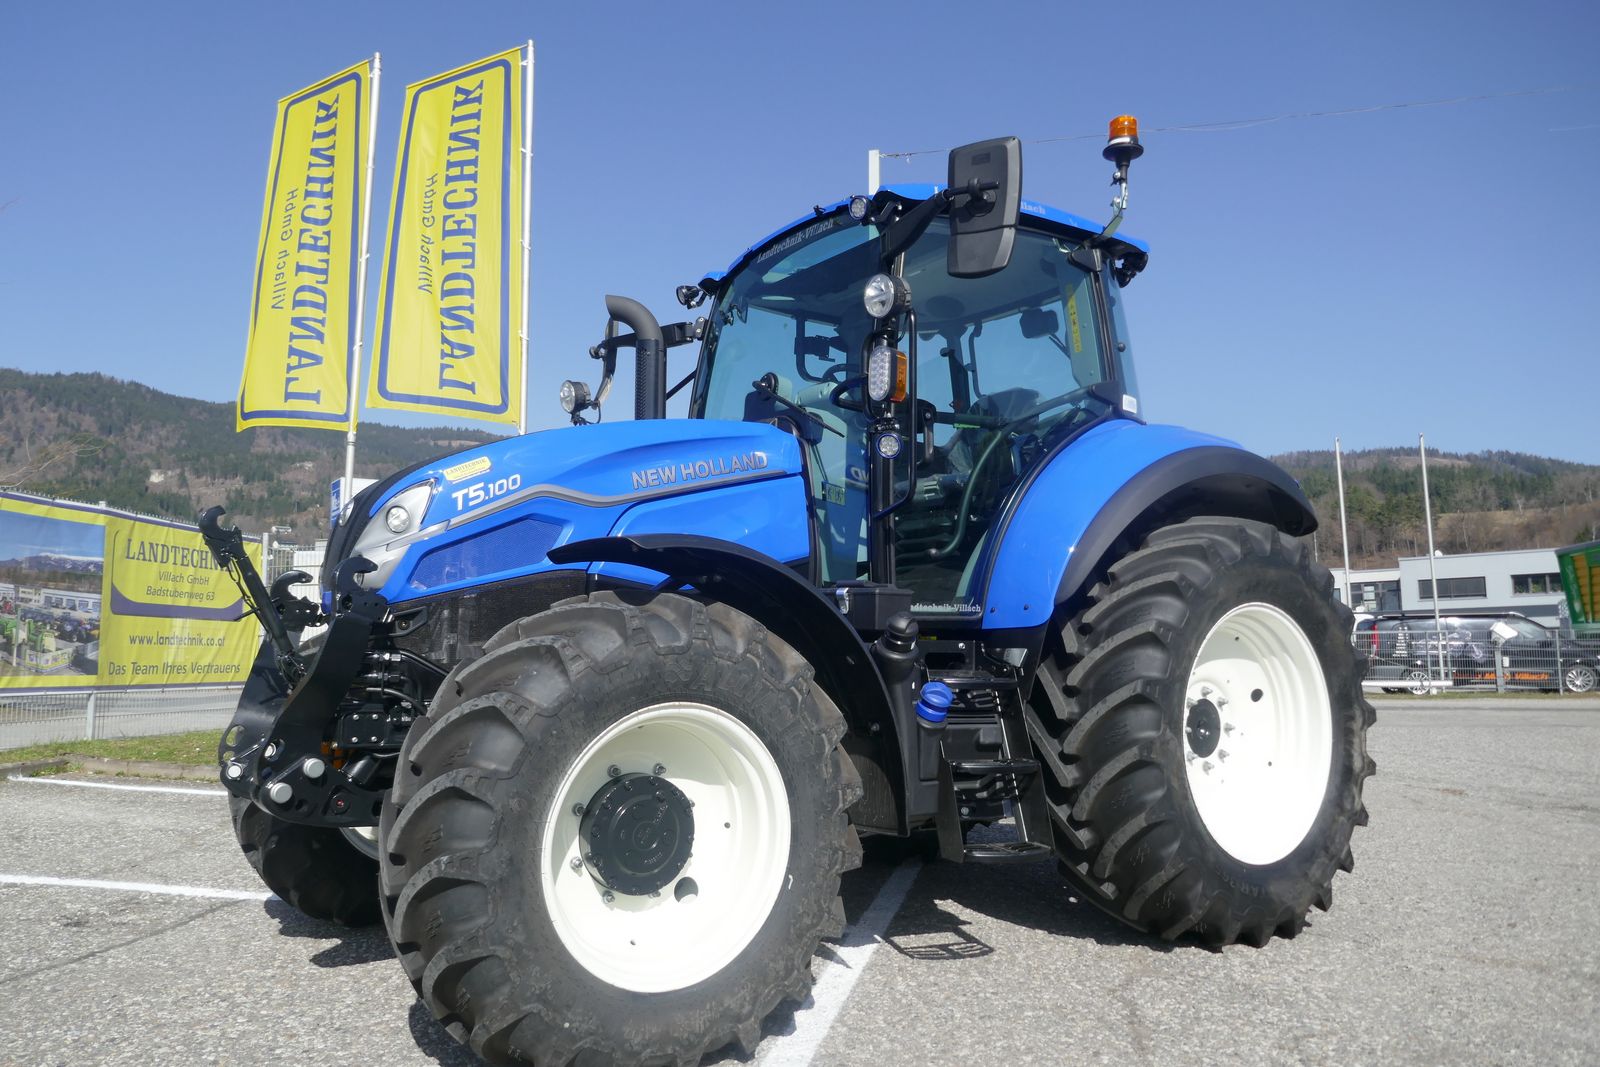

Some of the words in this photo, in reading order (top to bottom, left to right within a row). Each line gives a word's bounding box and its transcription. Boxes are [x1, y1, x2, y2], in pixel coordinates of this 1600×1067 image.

[631, 464, 677, 490] NEW
[680, 451, 768, 481] HOLLAND
[451, 473, 521, 511] T5.100
[158, 571, 185, 583] Villach
[187, 574, 210, 586] GmbH
[146, 585, 204, 603] Badstubenweg
[205, 591, 215, 601] 63
[108, 661, 127, 676] Das
[131, 661, 159, 676] Team
[162, 661, 187, 675] Ihres
[191, 662, 241, 675] Vertrauens
